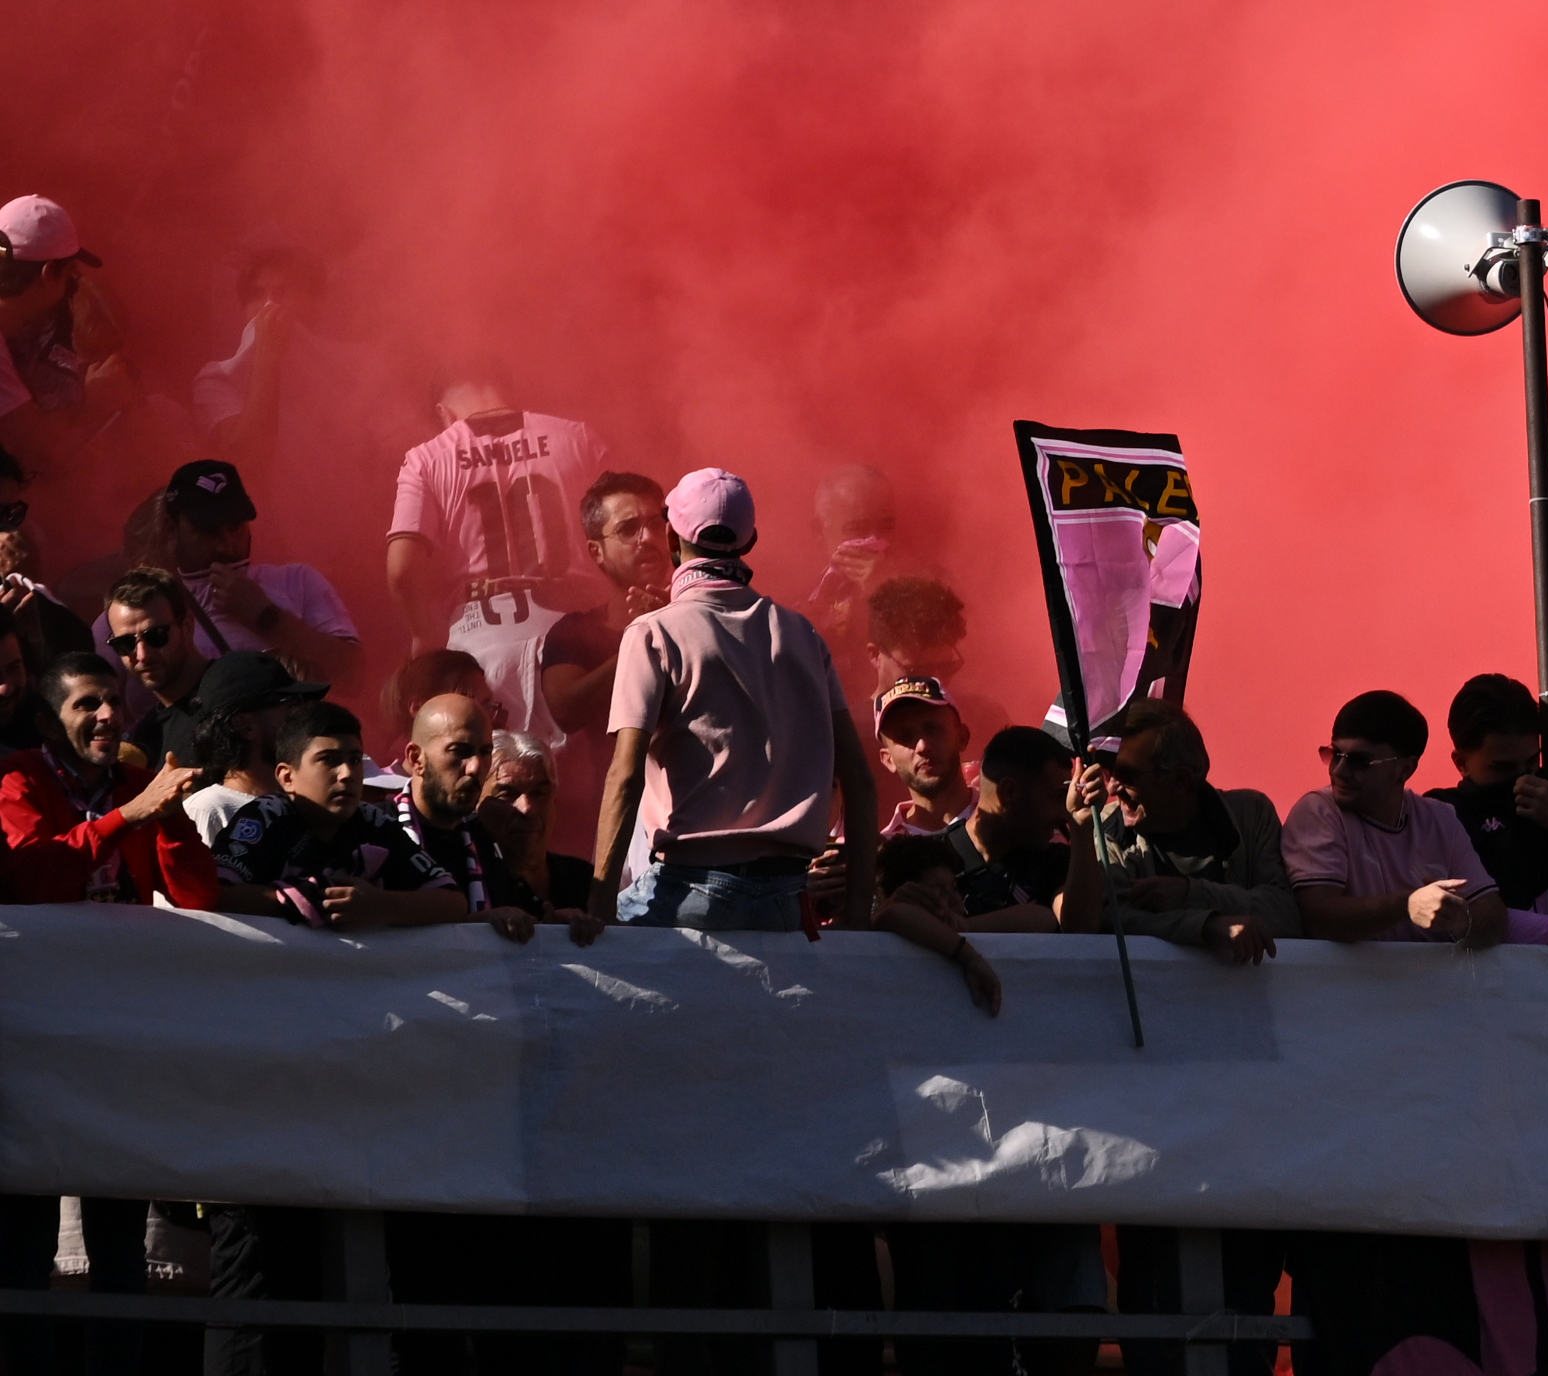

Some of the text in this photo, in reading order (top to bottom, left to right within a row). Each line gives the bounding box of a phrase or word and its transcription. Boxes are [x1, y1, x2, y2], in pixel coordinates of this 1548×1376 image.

[457, 435, 551, 471] SAMUELE
[1057, 458, 1199, 516] PALE
[467, 473, 572, 581] 10
